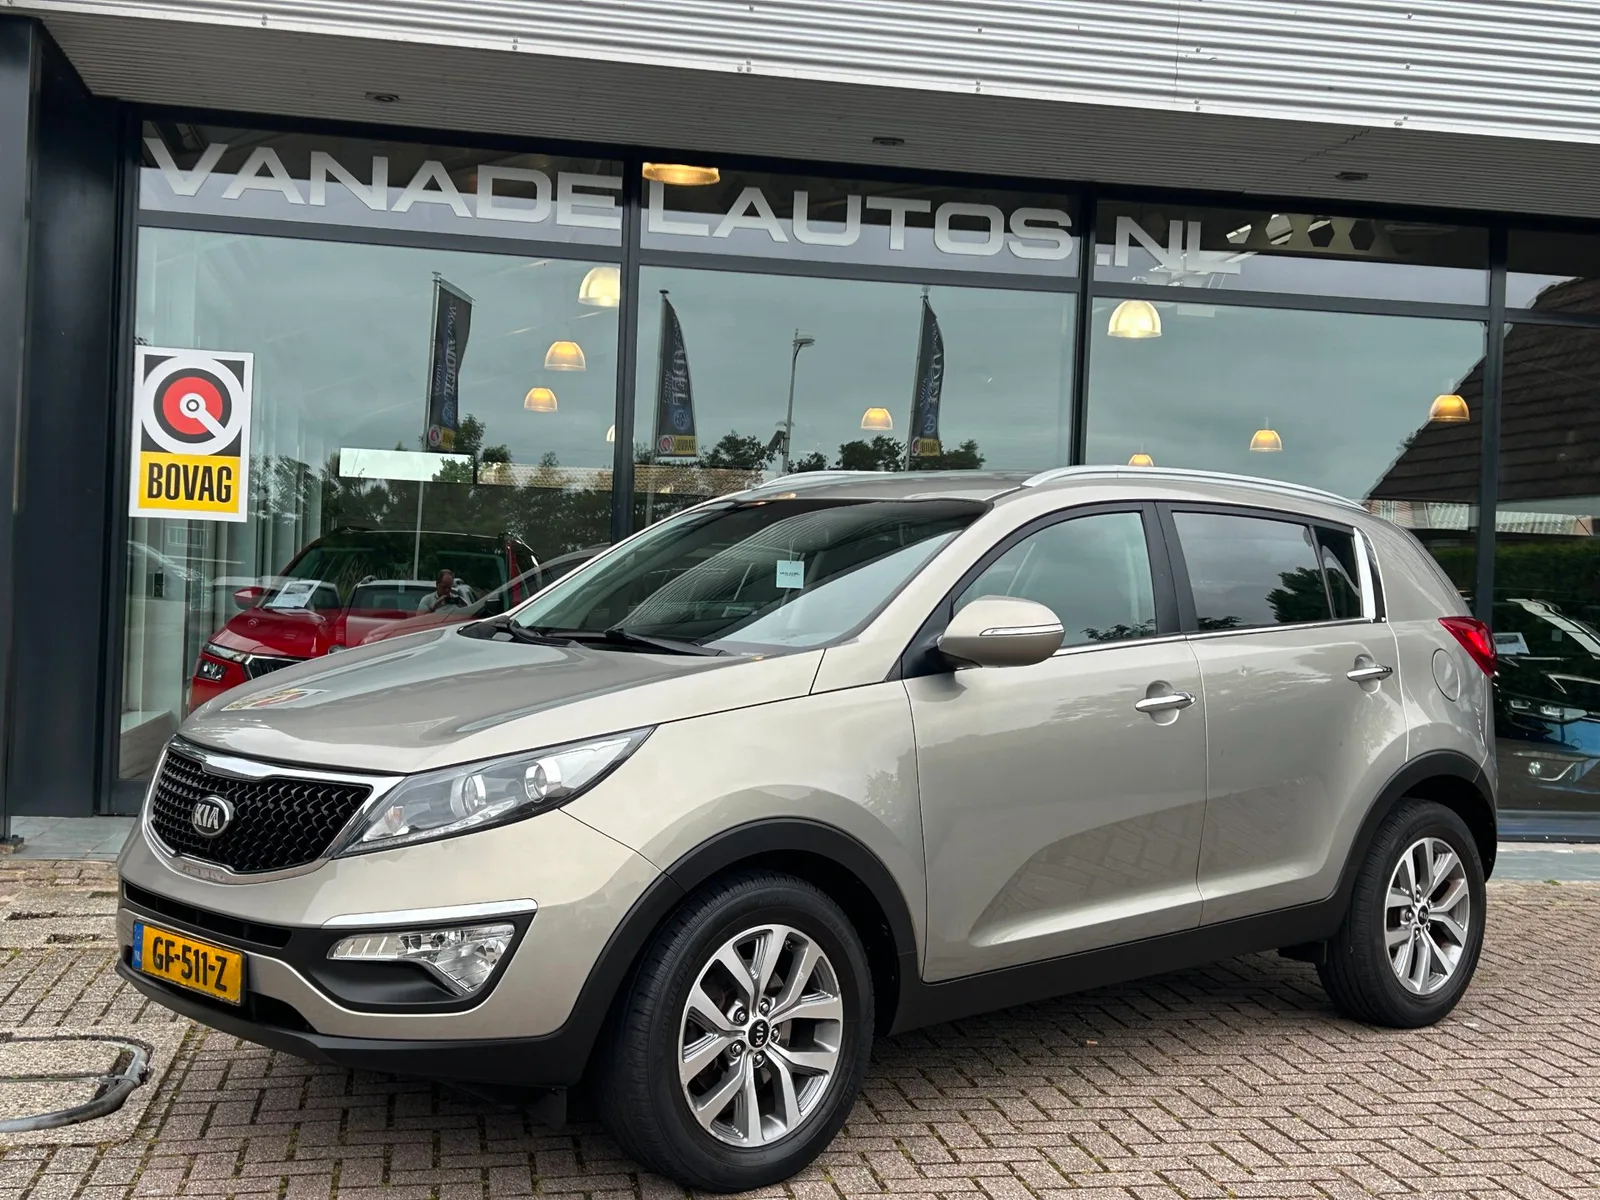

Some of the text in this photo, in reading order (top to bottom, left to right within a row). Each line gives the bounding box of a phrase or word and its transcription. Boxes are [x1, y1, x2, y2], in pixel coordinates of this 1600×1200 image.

[147, 462, 232, 503] BOVAG
[194, 803, 220, 830] KIA
[152, 936, 228, 992] GF-511-Z
[755, 1023, 764, 1045] KIA
